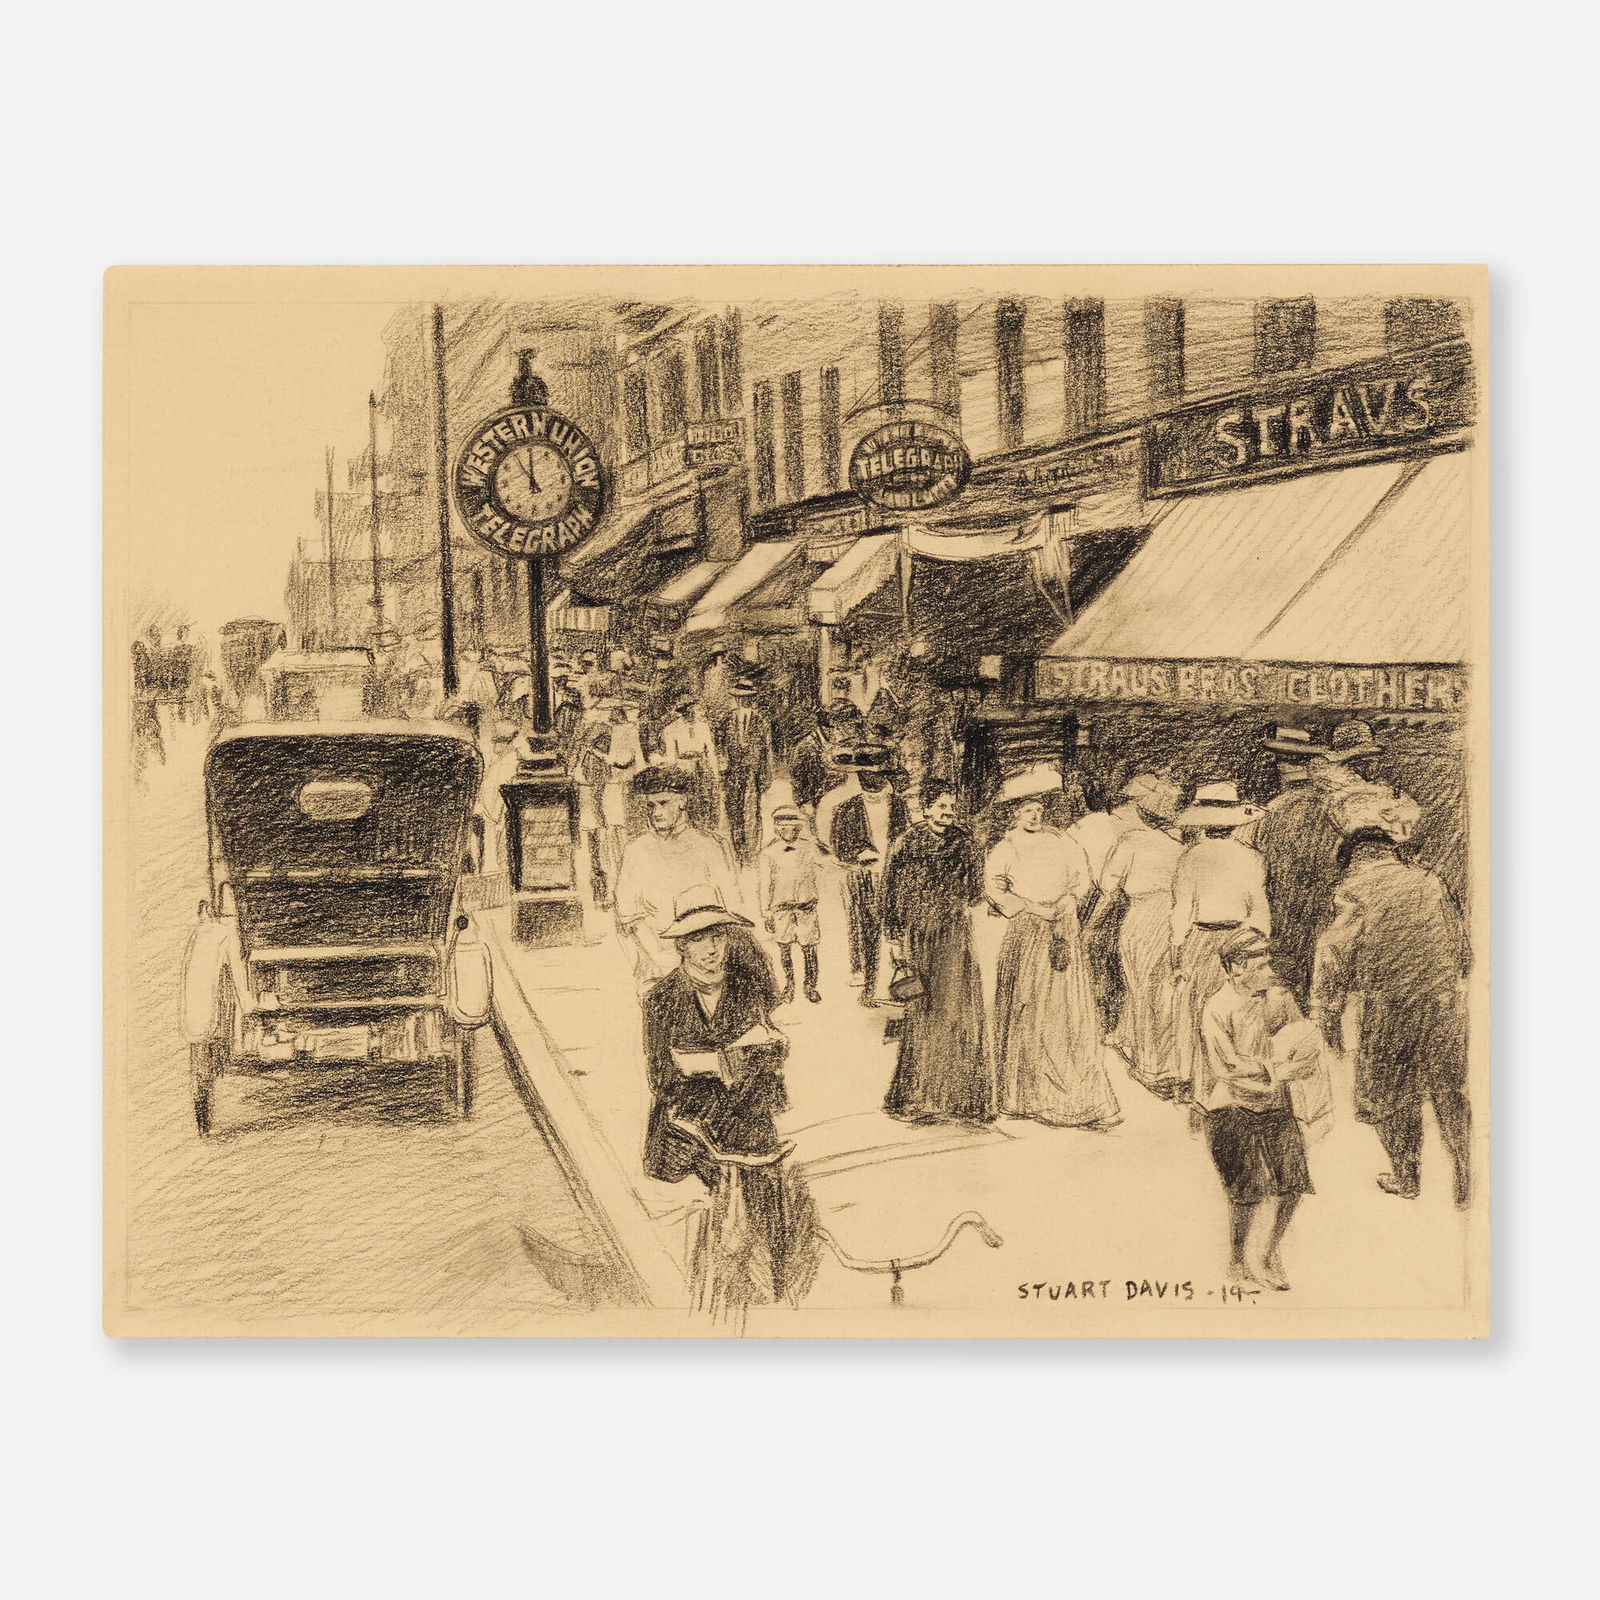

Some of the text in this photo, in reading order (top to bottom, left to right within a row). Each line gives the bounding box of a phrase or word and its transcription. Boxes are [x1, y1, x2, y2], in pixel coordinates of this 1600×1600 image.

[461, 411, 548, 487] WESTERN
[550, 421, 600, 487] UNION
[855, 447, 964, 479] TELEGRAPH
[471, 502, 593, 554] TELEGRAPH
[1050, 661, 1168, 698] STRAUS
[1018, 1280, 1111, 1301] STUART
[1125, 1279, 1195, 1300] DAVIS
